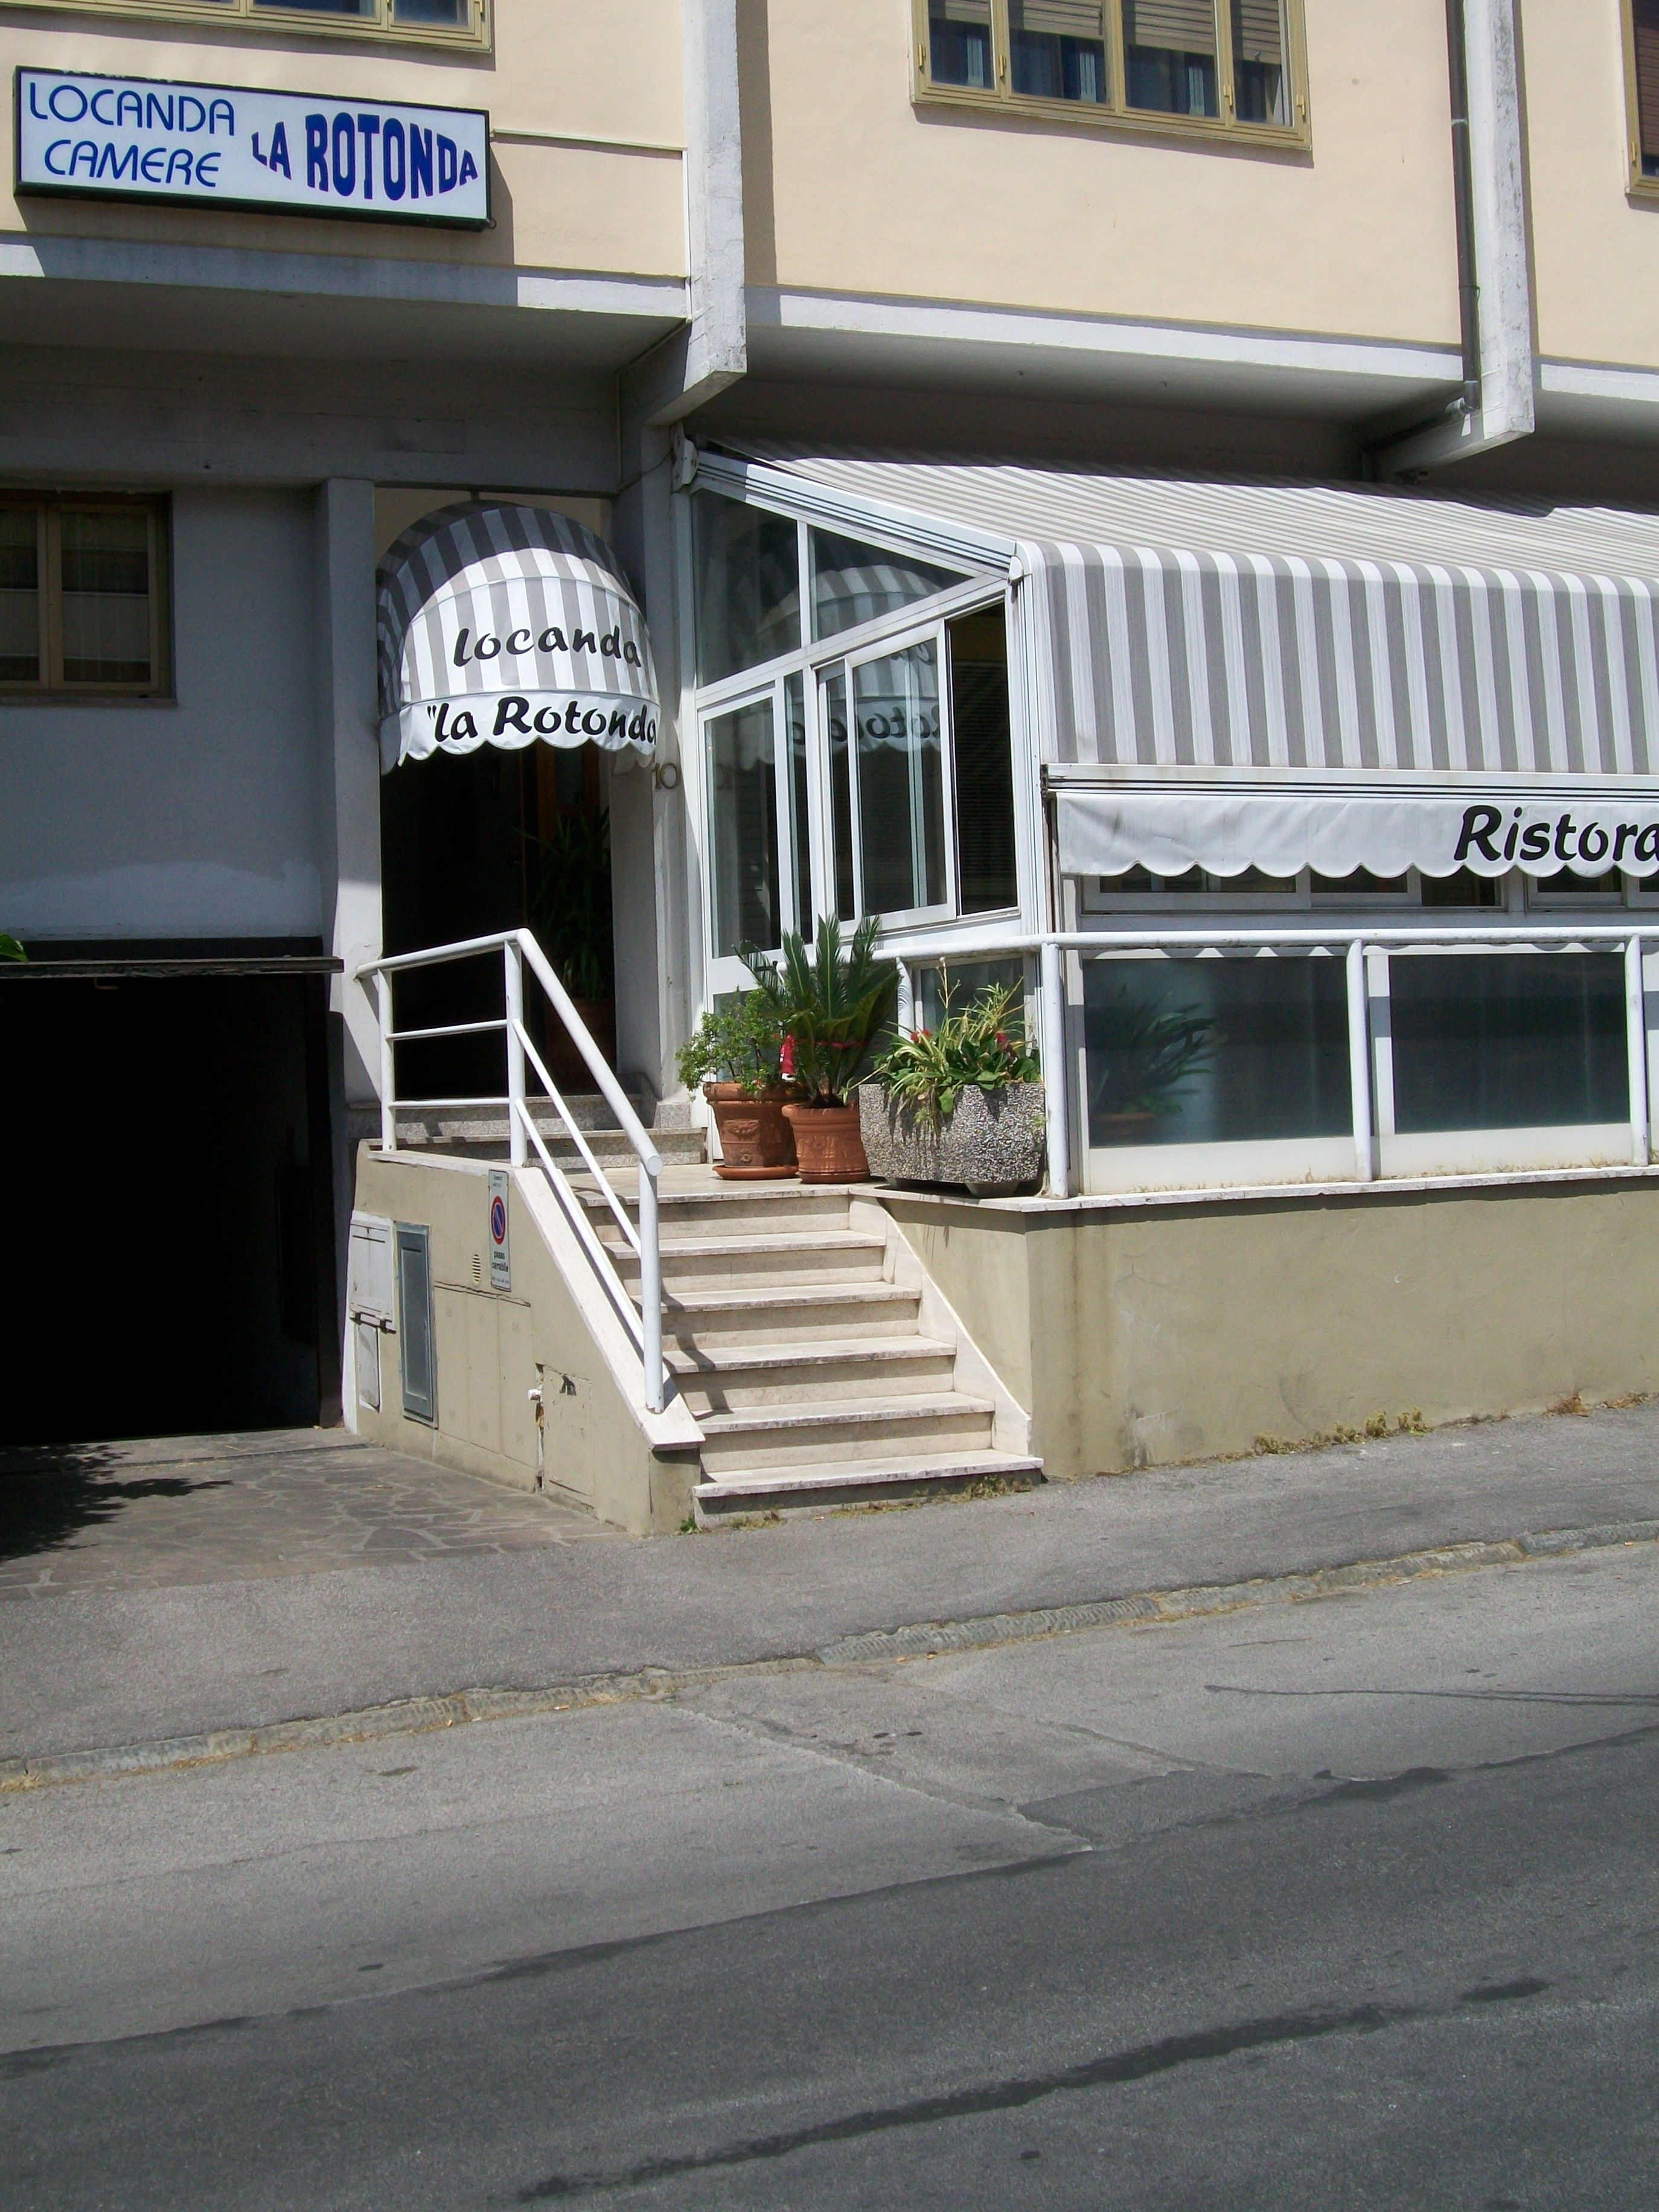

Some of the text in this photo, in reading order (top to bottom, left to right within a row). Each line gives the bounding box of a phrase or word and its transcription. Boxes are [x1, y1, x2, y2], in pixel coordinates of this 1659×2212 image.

[30, 82, 235, 136] LOCANDA
[44, 138, 222, 188] CAMERE
[251, 112, 479, 201] LA ROTONDA
[492, 696, 656, 744] Rotonda
[652, 762, 679, 788] 10
[1454, 805, 1659, 861] Ristora
